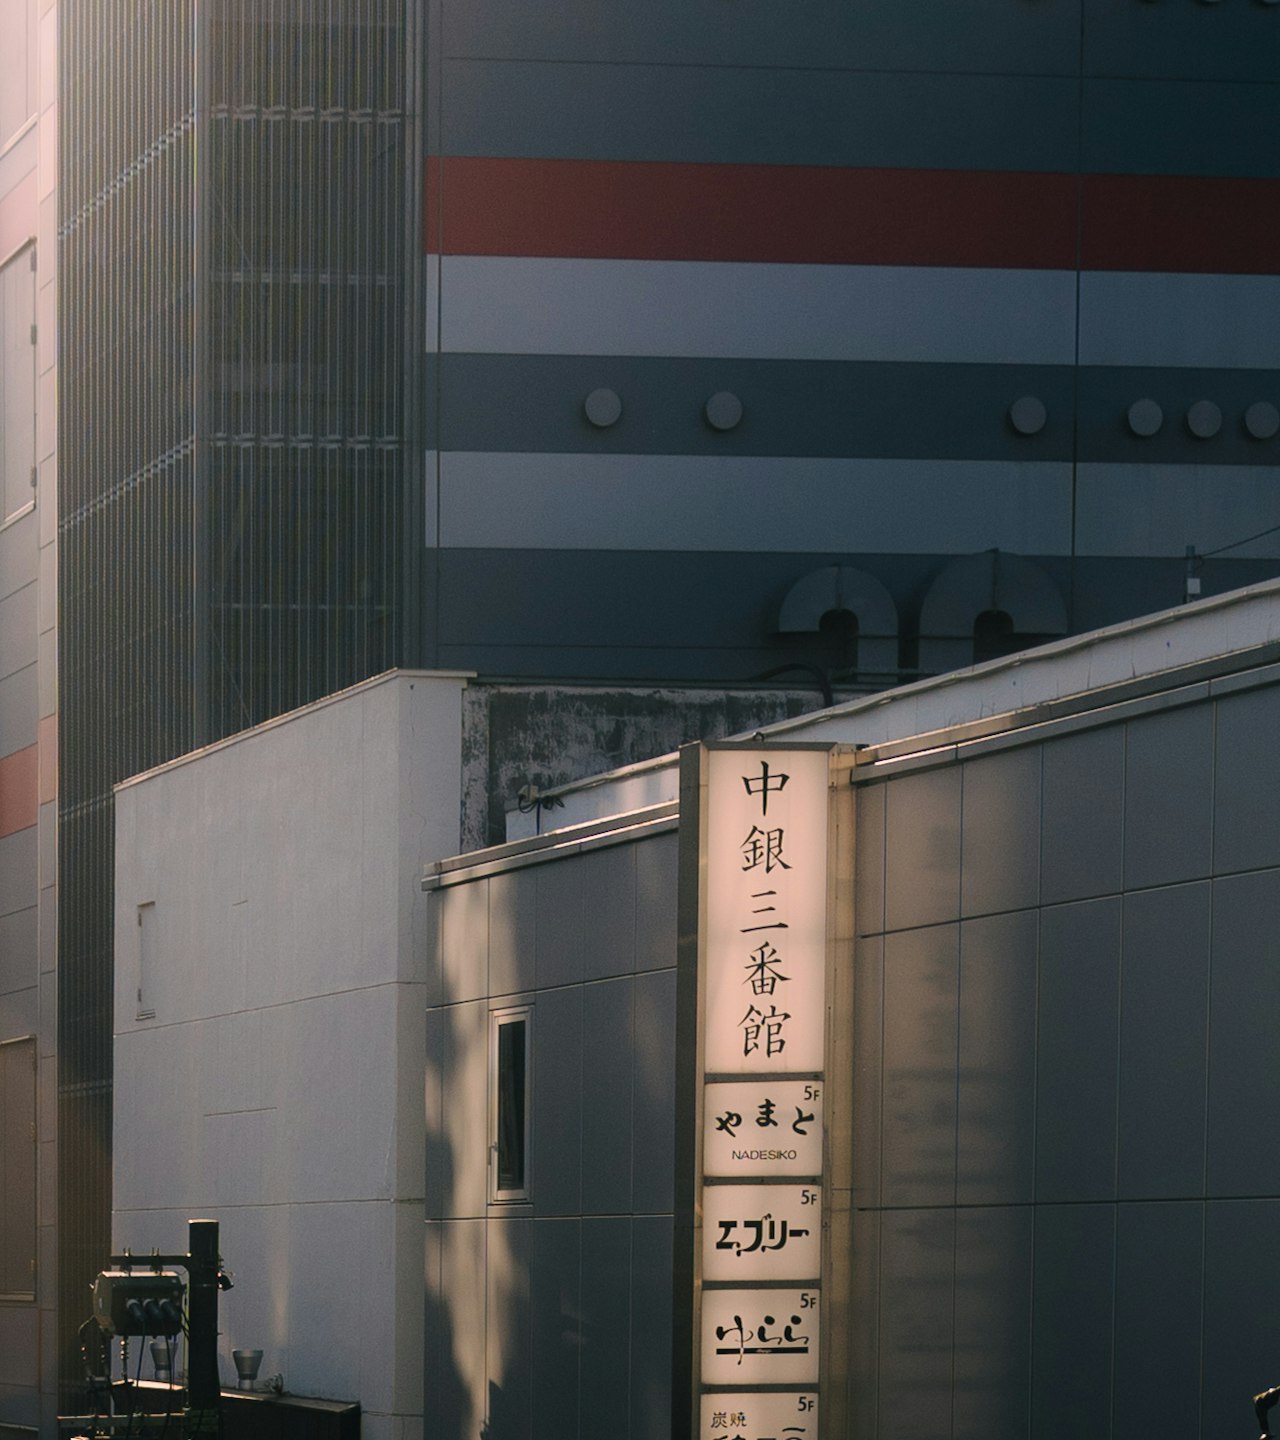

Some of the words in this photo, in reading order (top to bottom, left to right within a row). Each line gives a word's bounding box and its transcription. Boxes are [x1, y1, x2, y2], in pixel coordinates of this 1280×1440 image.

[738, 760, 793, 1059] 中銀三番館
[803, 1085, 820, 1101] 5F
[715, 1098, 815, 1138] やまと
[731, 1149, 797, 1161] NADESIKO
[800, 1189, 817, 1205] 5F
[715, 1213, 810, 1257] エブリー
[799, 1292, 817, 1309] 5F
[797, 1396, 815, 1412] 5F
